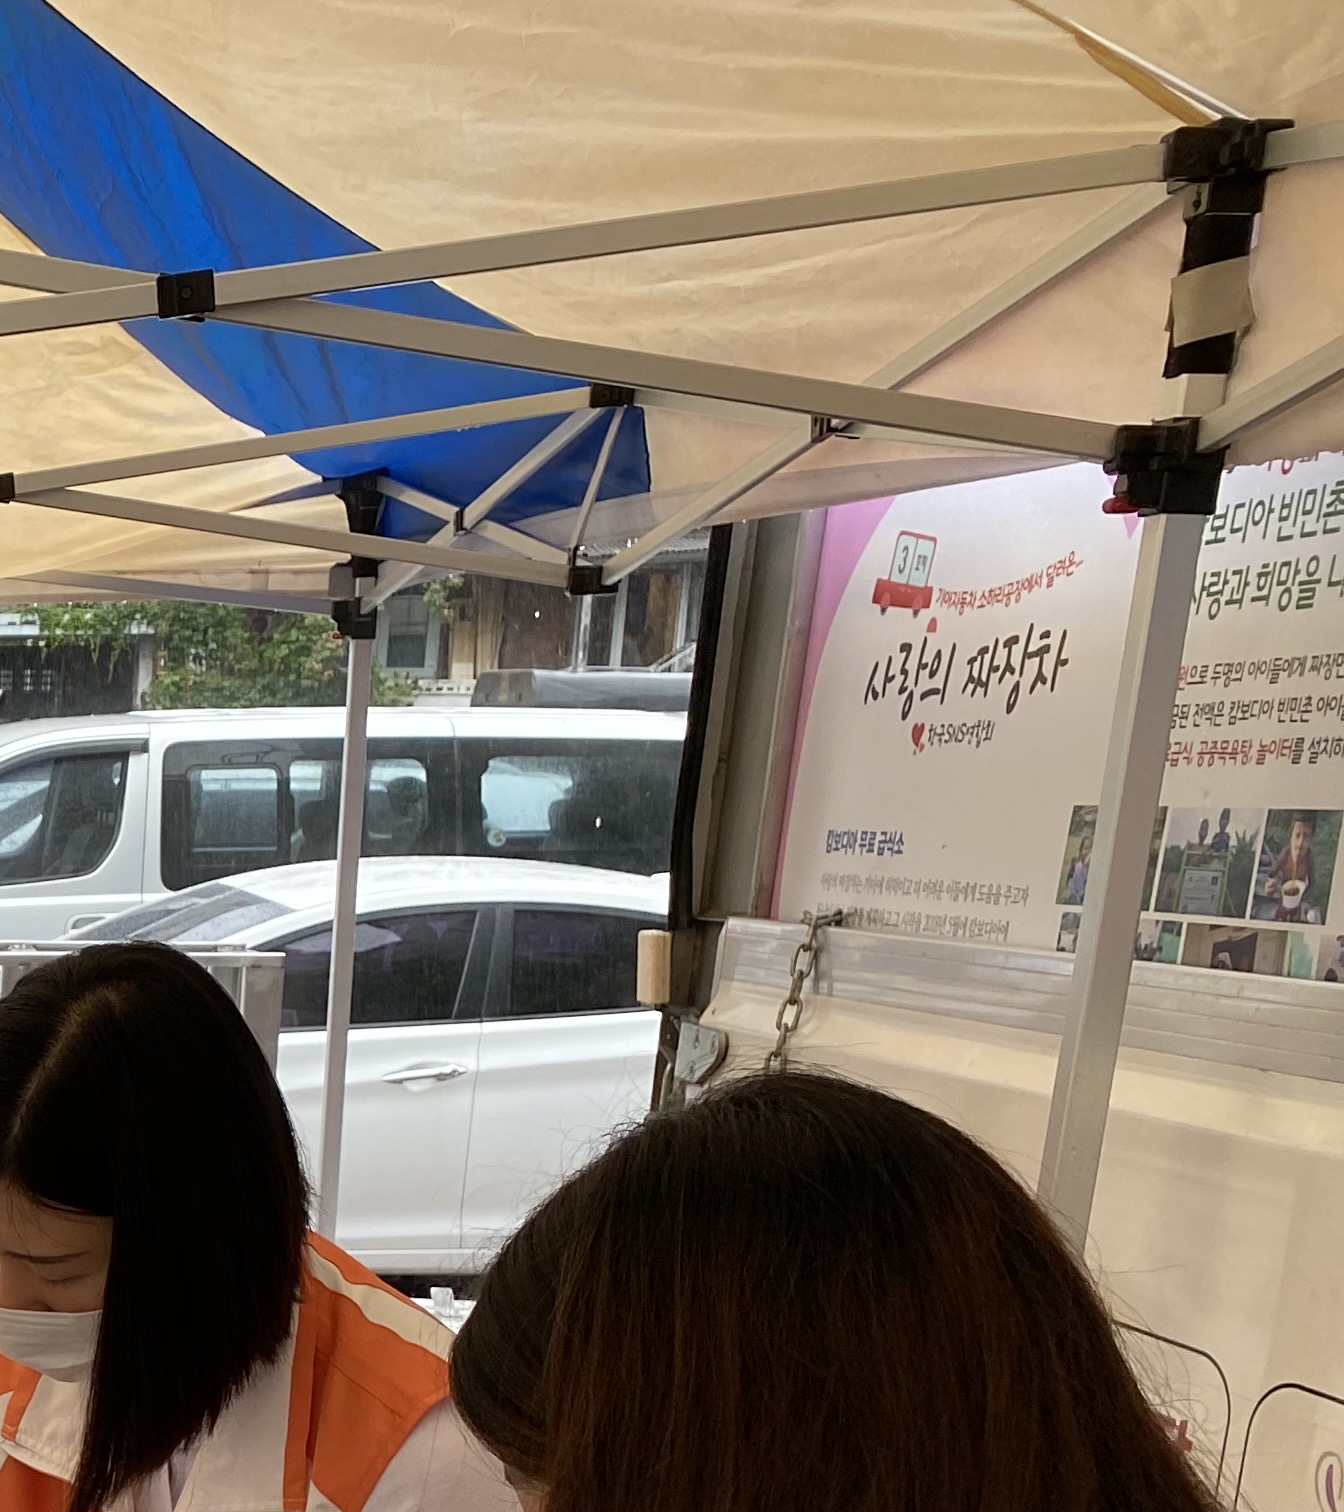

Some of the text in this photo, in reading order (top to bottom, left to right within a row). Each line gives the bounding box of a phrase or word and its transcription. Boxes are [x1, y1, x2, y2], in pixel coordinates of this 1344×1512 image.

[1203, 480, 1344, 546] 보디아 빈민촌
[1251, 554, 1322, 612] 희망을
[864, 622, 1069, 721] 사랑의 짜장차
[1211, 660, 1246, 688] 두명의
[1248, 654, 1308, 685] 아이들에게
[1193, 701, 1224, 728] 전액은
[1228, 698, 1274, 726] 캄보디아
[1277, 695, 1313, 723] 빈민촌
[1316, 694, 1344, 721] 아이
[1256, 737, 1305, 765] 놀이터를
[826, 829, 904, 857] 캄보디아 무료 급식소
